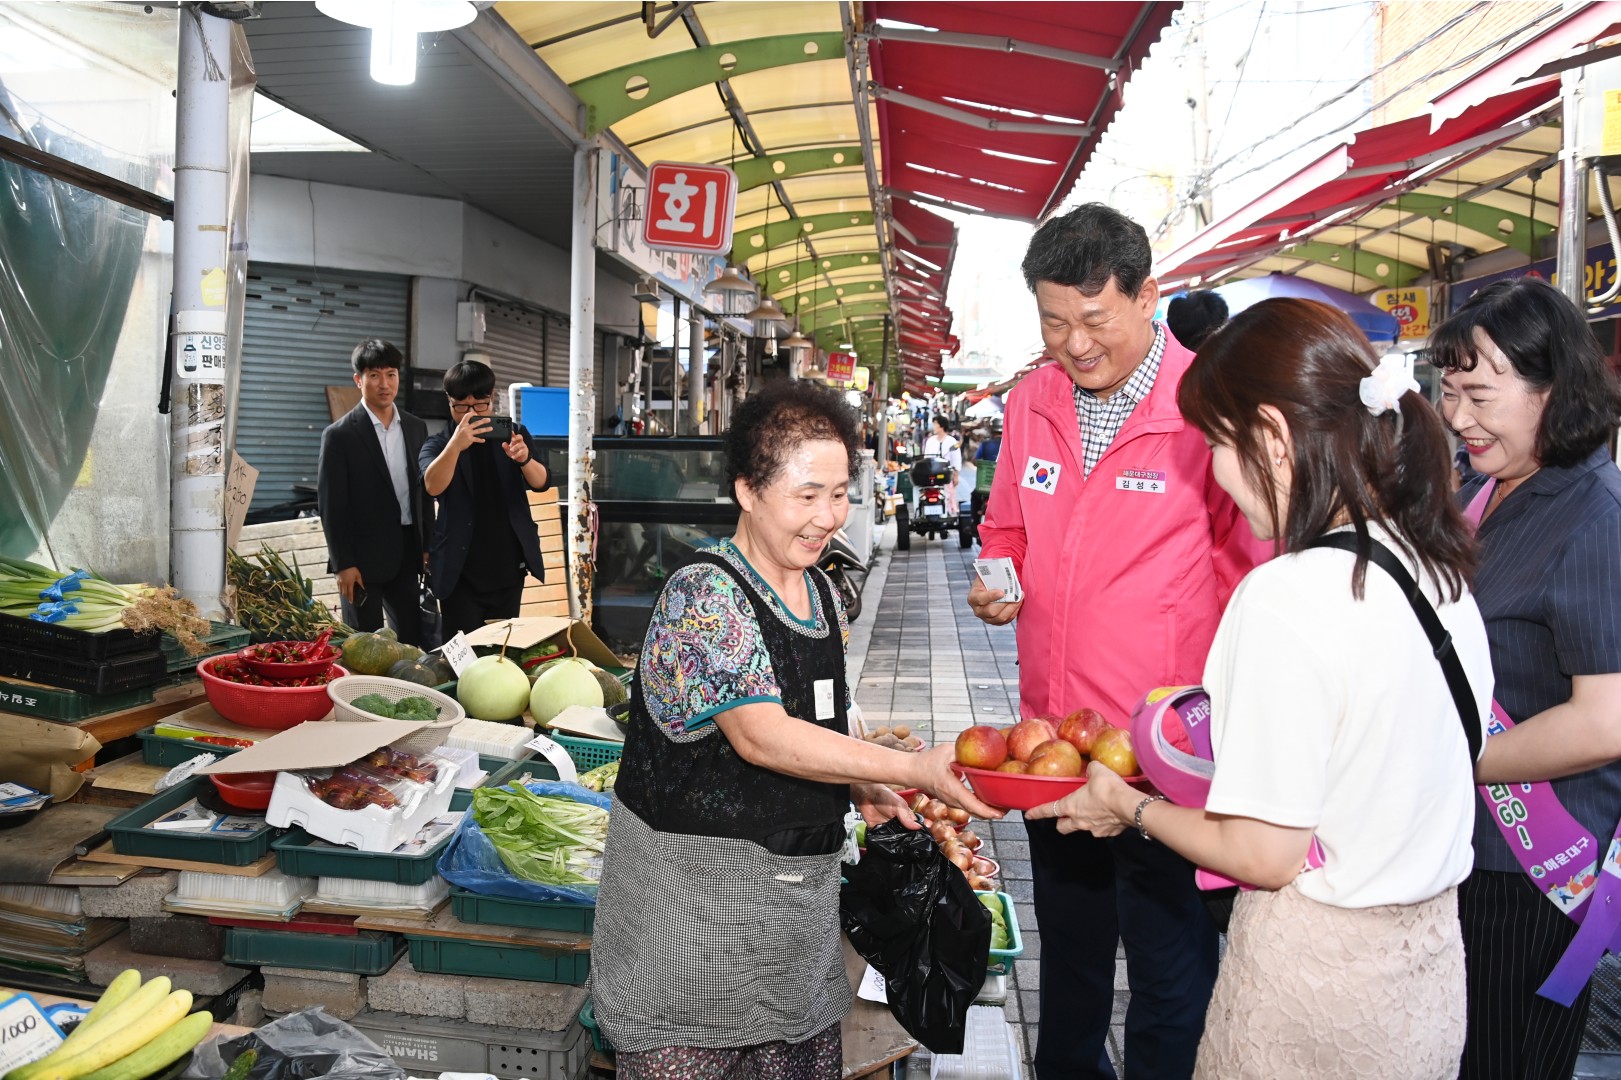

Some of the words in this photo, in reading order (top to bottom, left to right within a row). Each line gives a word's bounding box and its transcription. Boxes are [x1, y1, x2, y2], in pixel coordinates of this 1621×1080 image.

[655, 172, 718, 239] 회
[1386, 291, 1417, 305] 참새
[1391, 306, 1413, 322] 떡
[1398, 324, 1428, 337] 앗간
[1186, 699, 1210, 728] 운대구
[1543, 836, 1590, 872] 해운대구
[385, 1045, 438, 1061] SHANY
